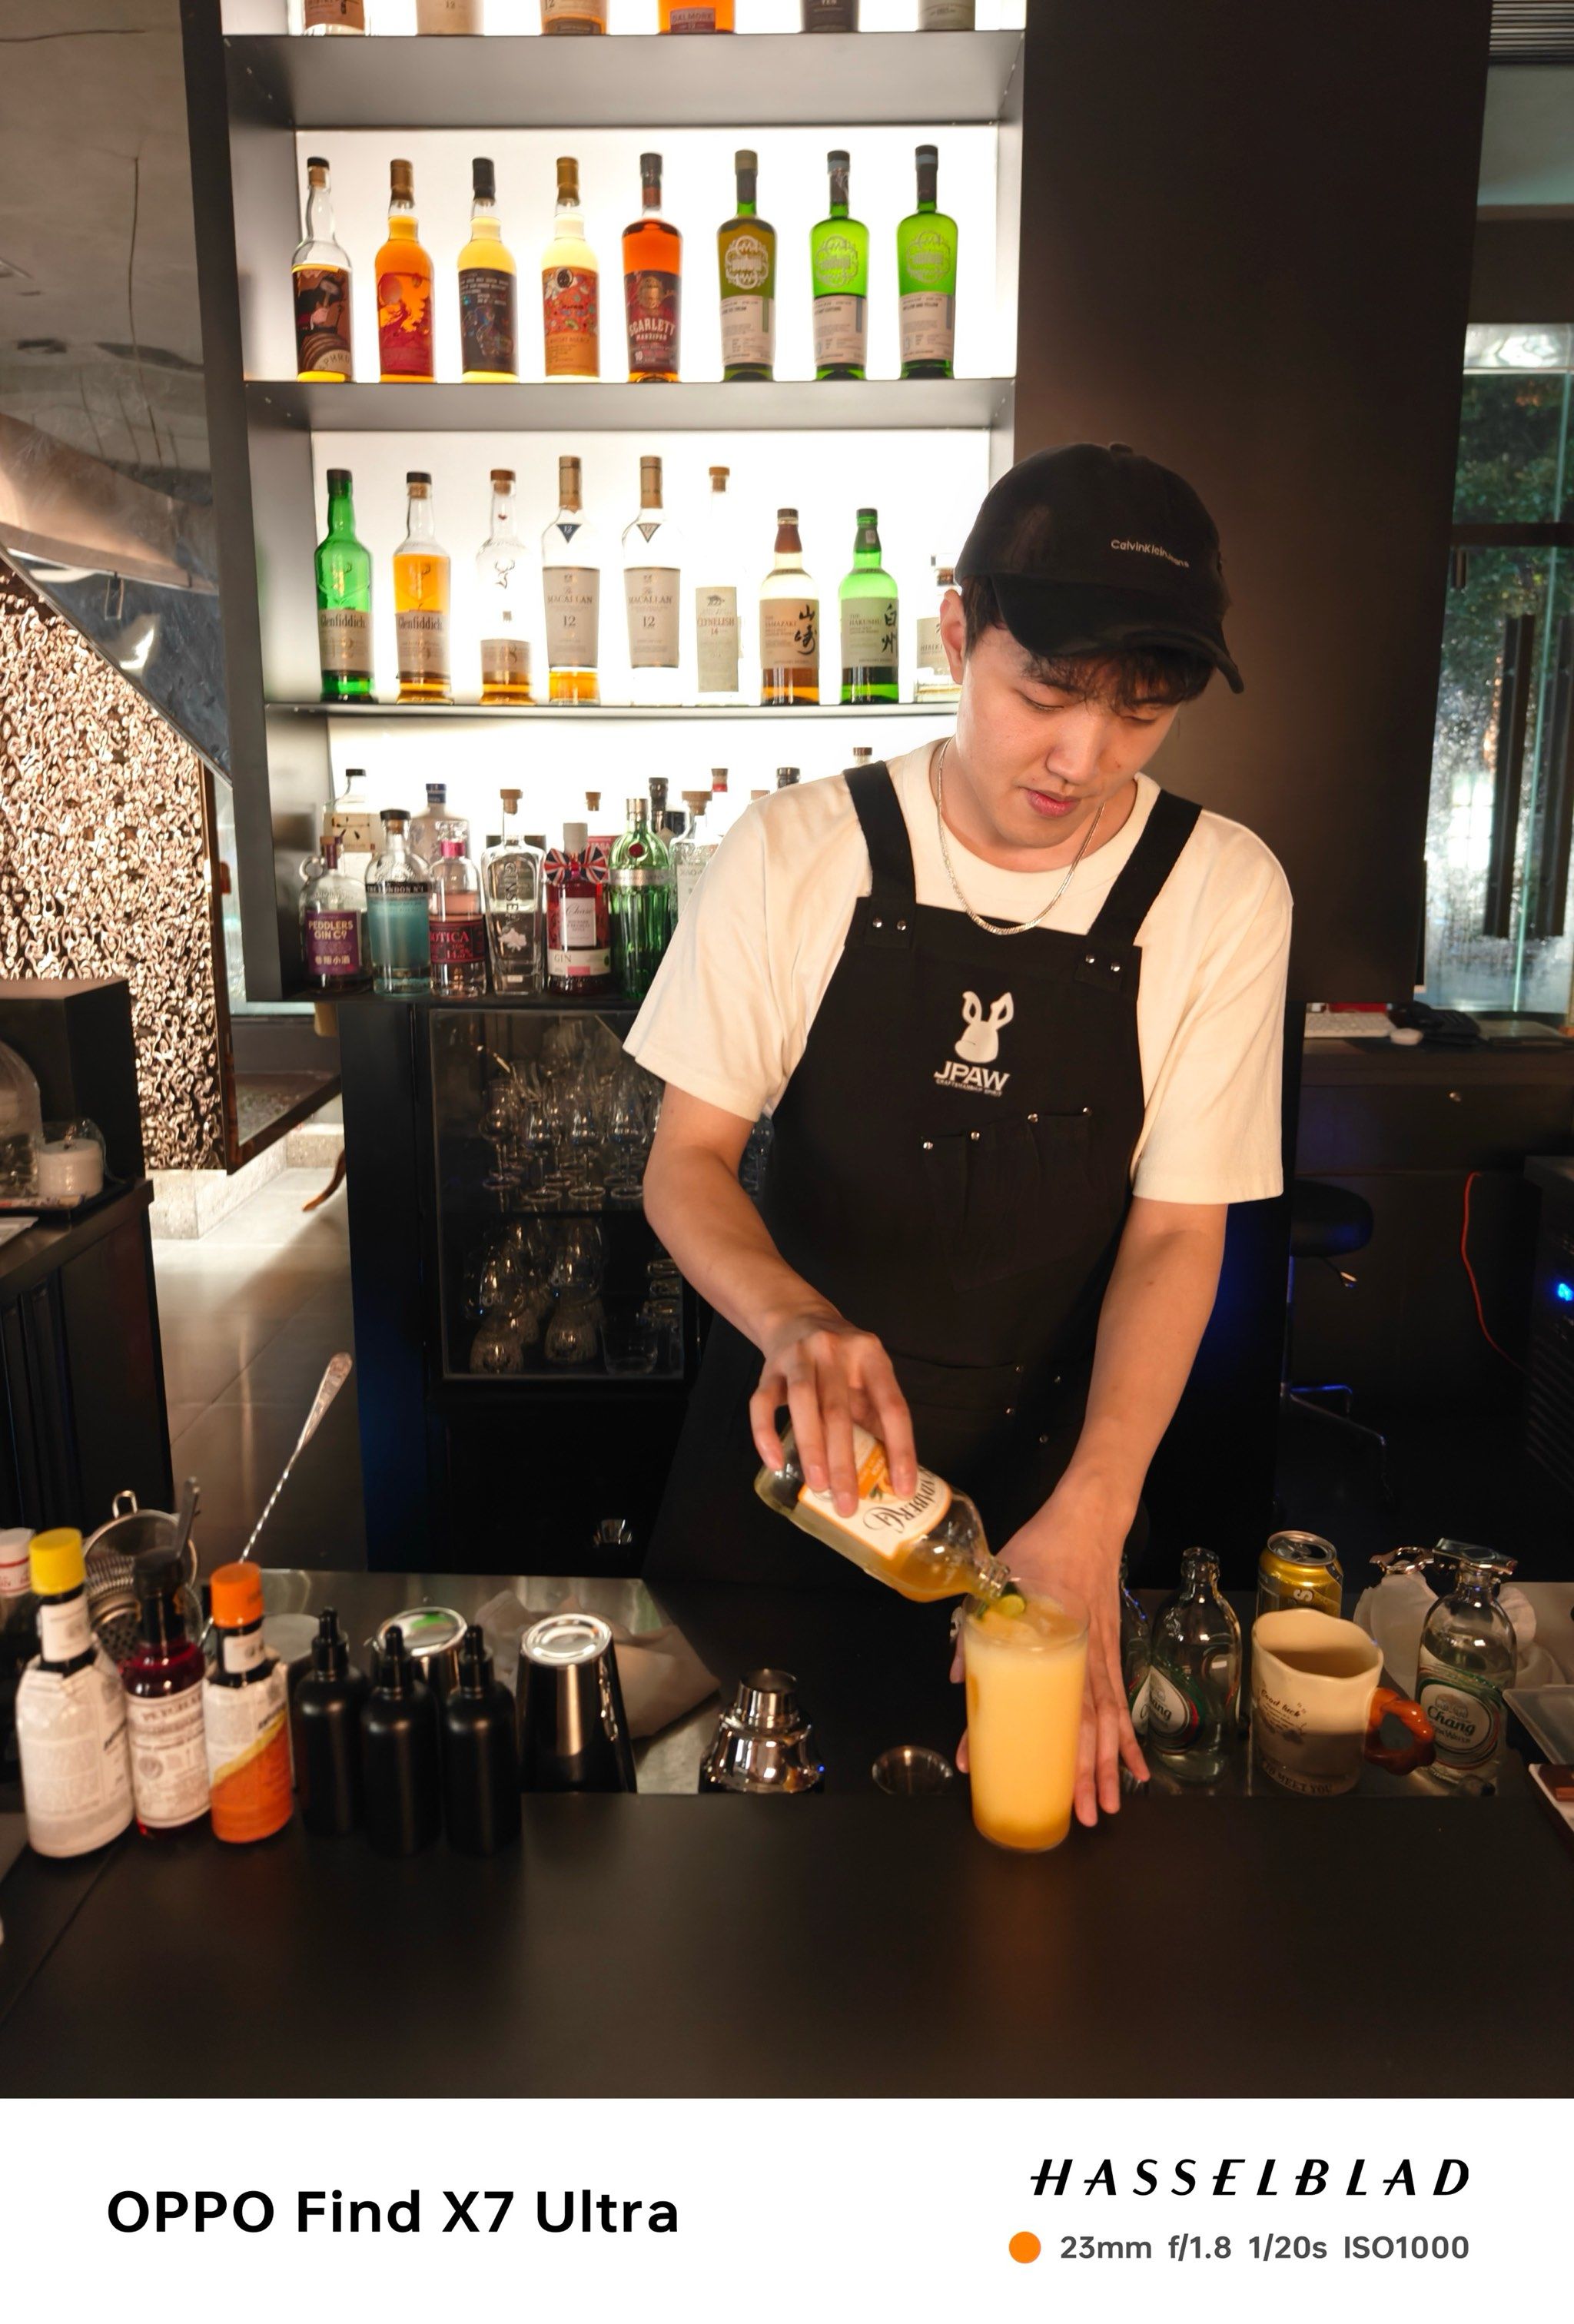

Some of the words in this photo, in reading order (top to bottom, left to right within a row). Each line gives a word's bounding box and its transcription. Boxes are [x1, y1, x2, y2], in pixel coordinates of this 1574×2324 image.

[629, 317, 676, 337] SCARLETT
[547, 594, 593, 605] MACALLAN
[628, 595, 672, 605] MACALLAN
[398, 616, 443, 630] Glenfiddich
[563, 615, 576, 627] 12
[643, 616, 656, 629] 12
[308, 920, 354, 931] PEDDLERS
[314, 930, 332, 941] GIN
[554, 954, 572, 963] GIN
[933, 1060, 1011, 1091] JPAW
[1427, 1705, 1476, 1736] Chang
